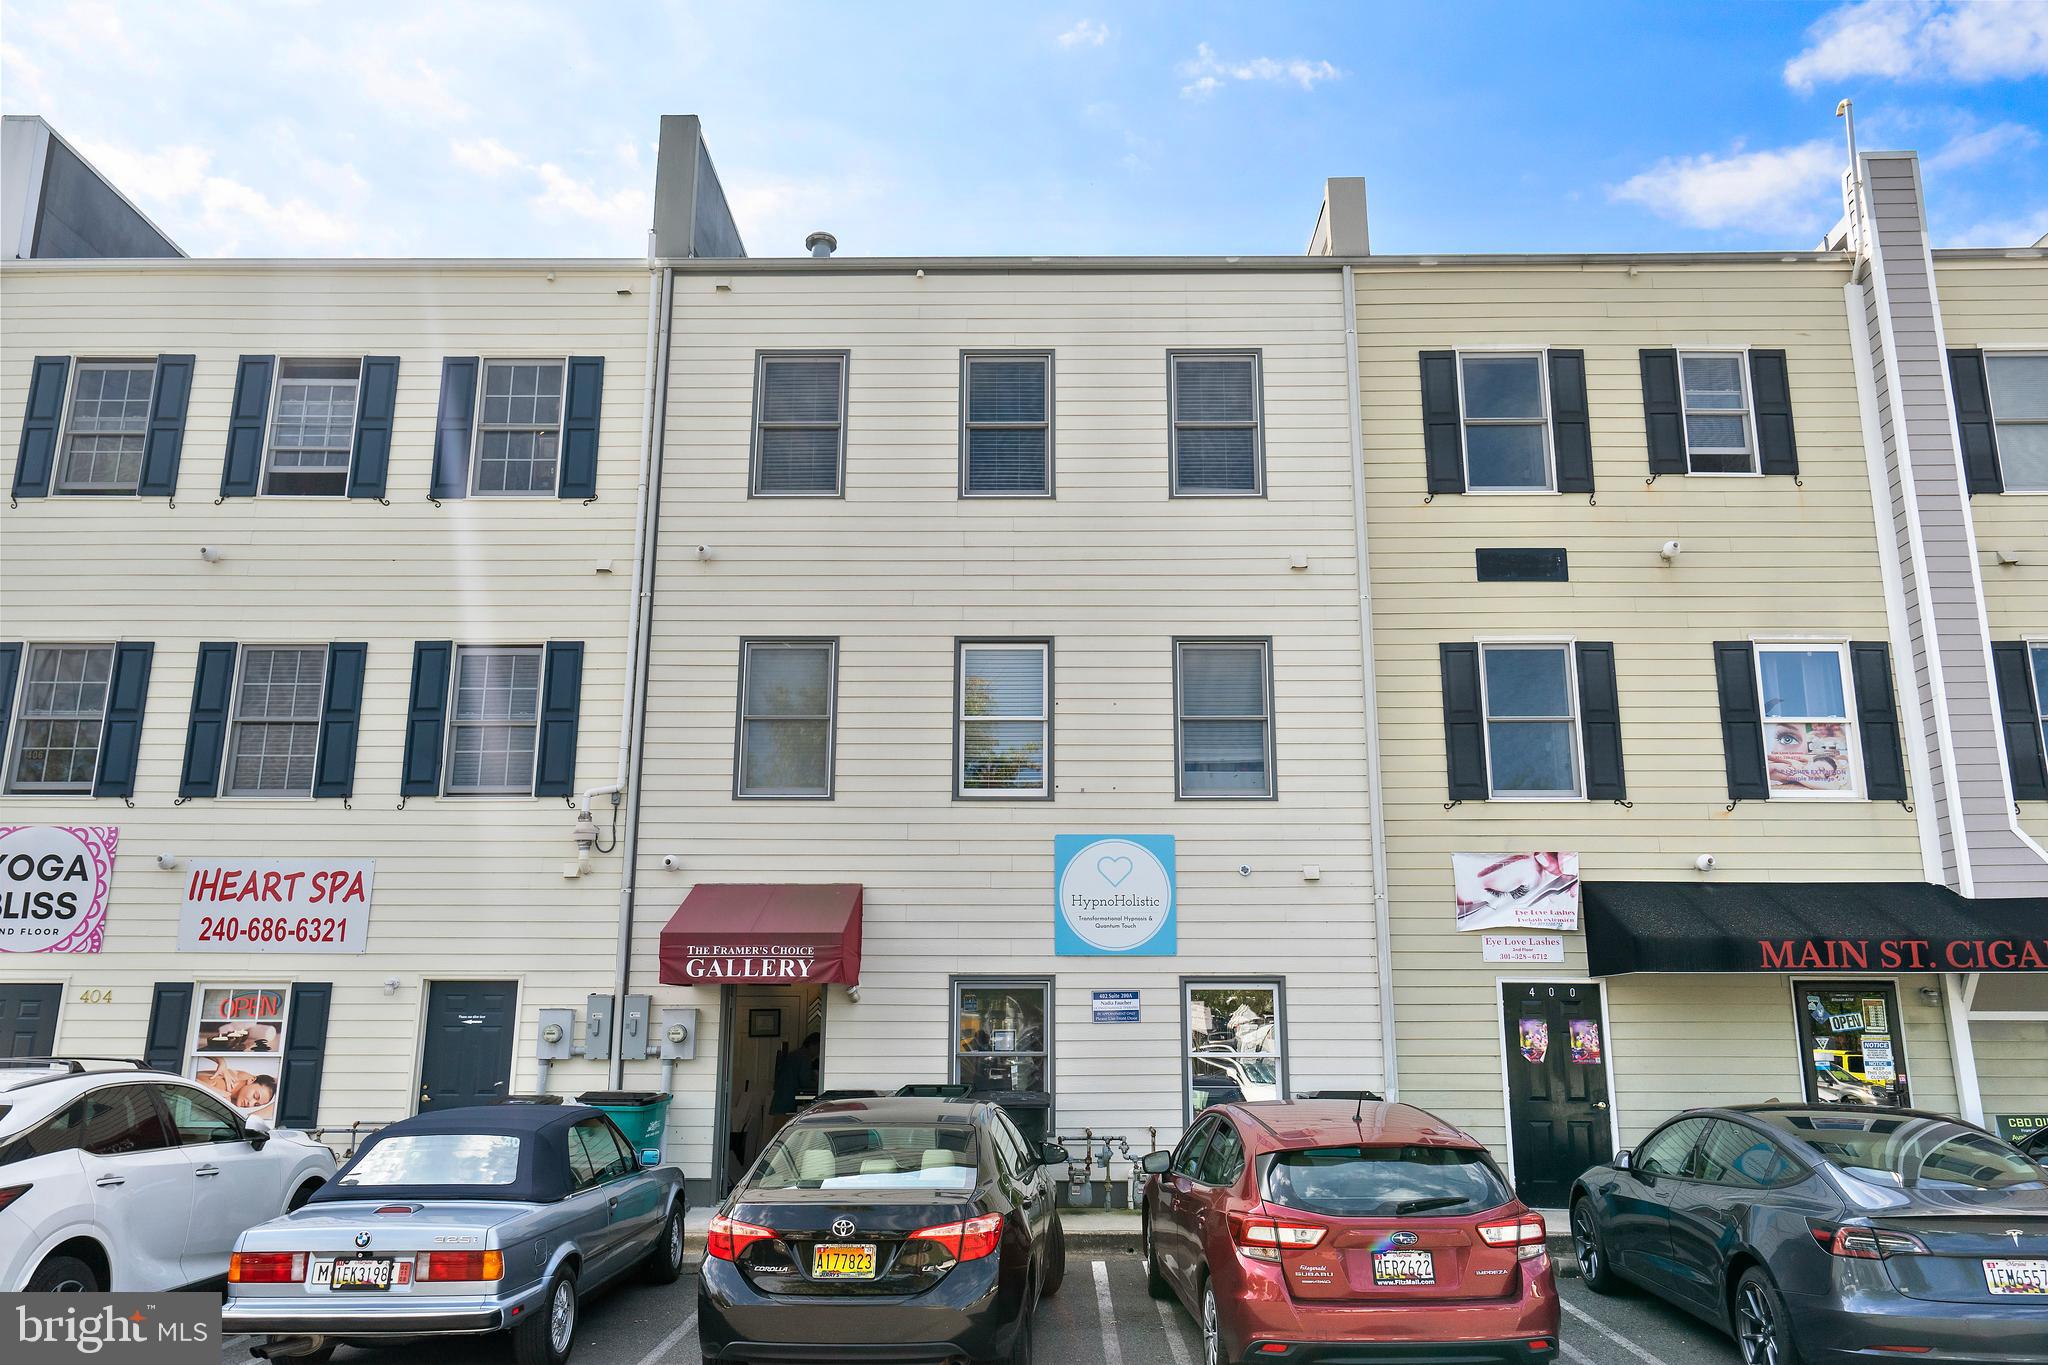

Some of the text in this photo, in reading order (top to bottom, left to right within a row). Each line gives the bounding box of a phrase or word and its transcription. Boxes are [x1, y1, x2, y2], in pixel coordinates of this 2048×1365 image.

[188, 867, 365, 903] IHEART SPA
[0, 892, 77, 919] LISS
[1071, 893, 1160, 910] HypnoHolistic
[198, 916, 347, 942] 240-686-6321
[686, 945, 815, 955] THE FRAMER'S CHOICE
[1485, 937, 1560, 947] Eye Love Lashes
[1758, 939, 1868, 968] MAIN
[1880, 939, 1937, 968] ST.
[686, 958, 815, 978] GALLERY
[80, 989, 112, 1004] 404
[219, 995, 279, 1018] OPEN
[1832, 1014, 1862, 1030] OPEN
[2008, 1118, 2032, 1127] CBD
[433, 1235, 479, 1243] 325i
[817, 1253, 872, 1270] A177823
[317, 1265, 329, 1282] M
[336, 1266, 388, 1282] 1EK3198
